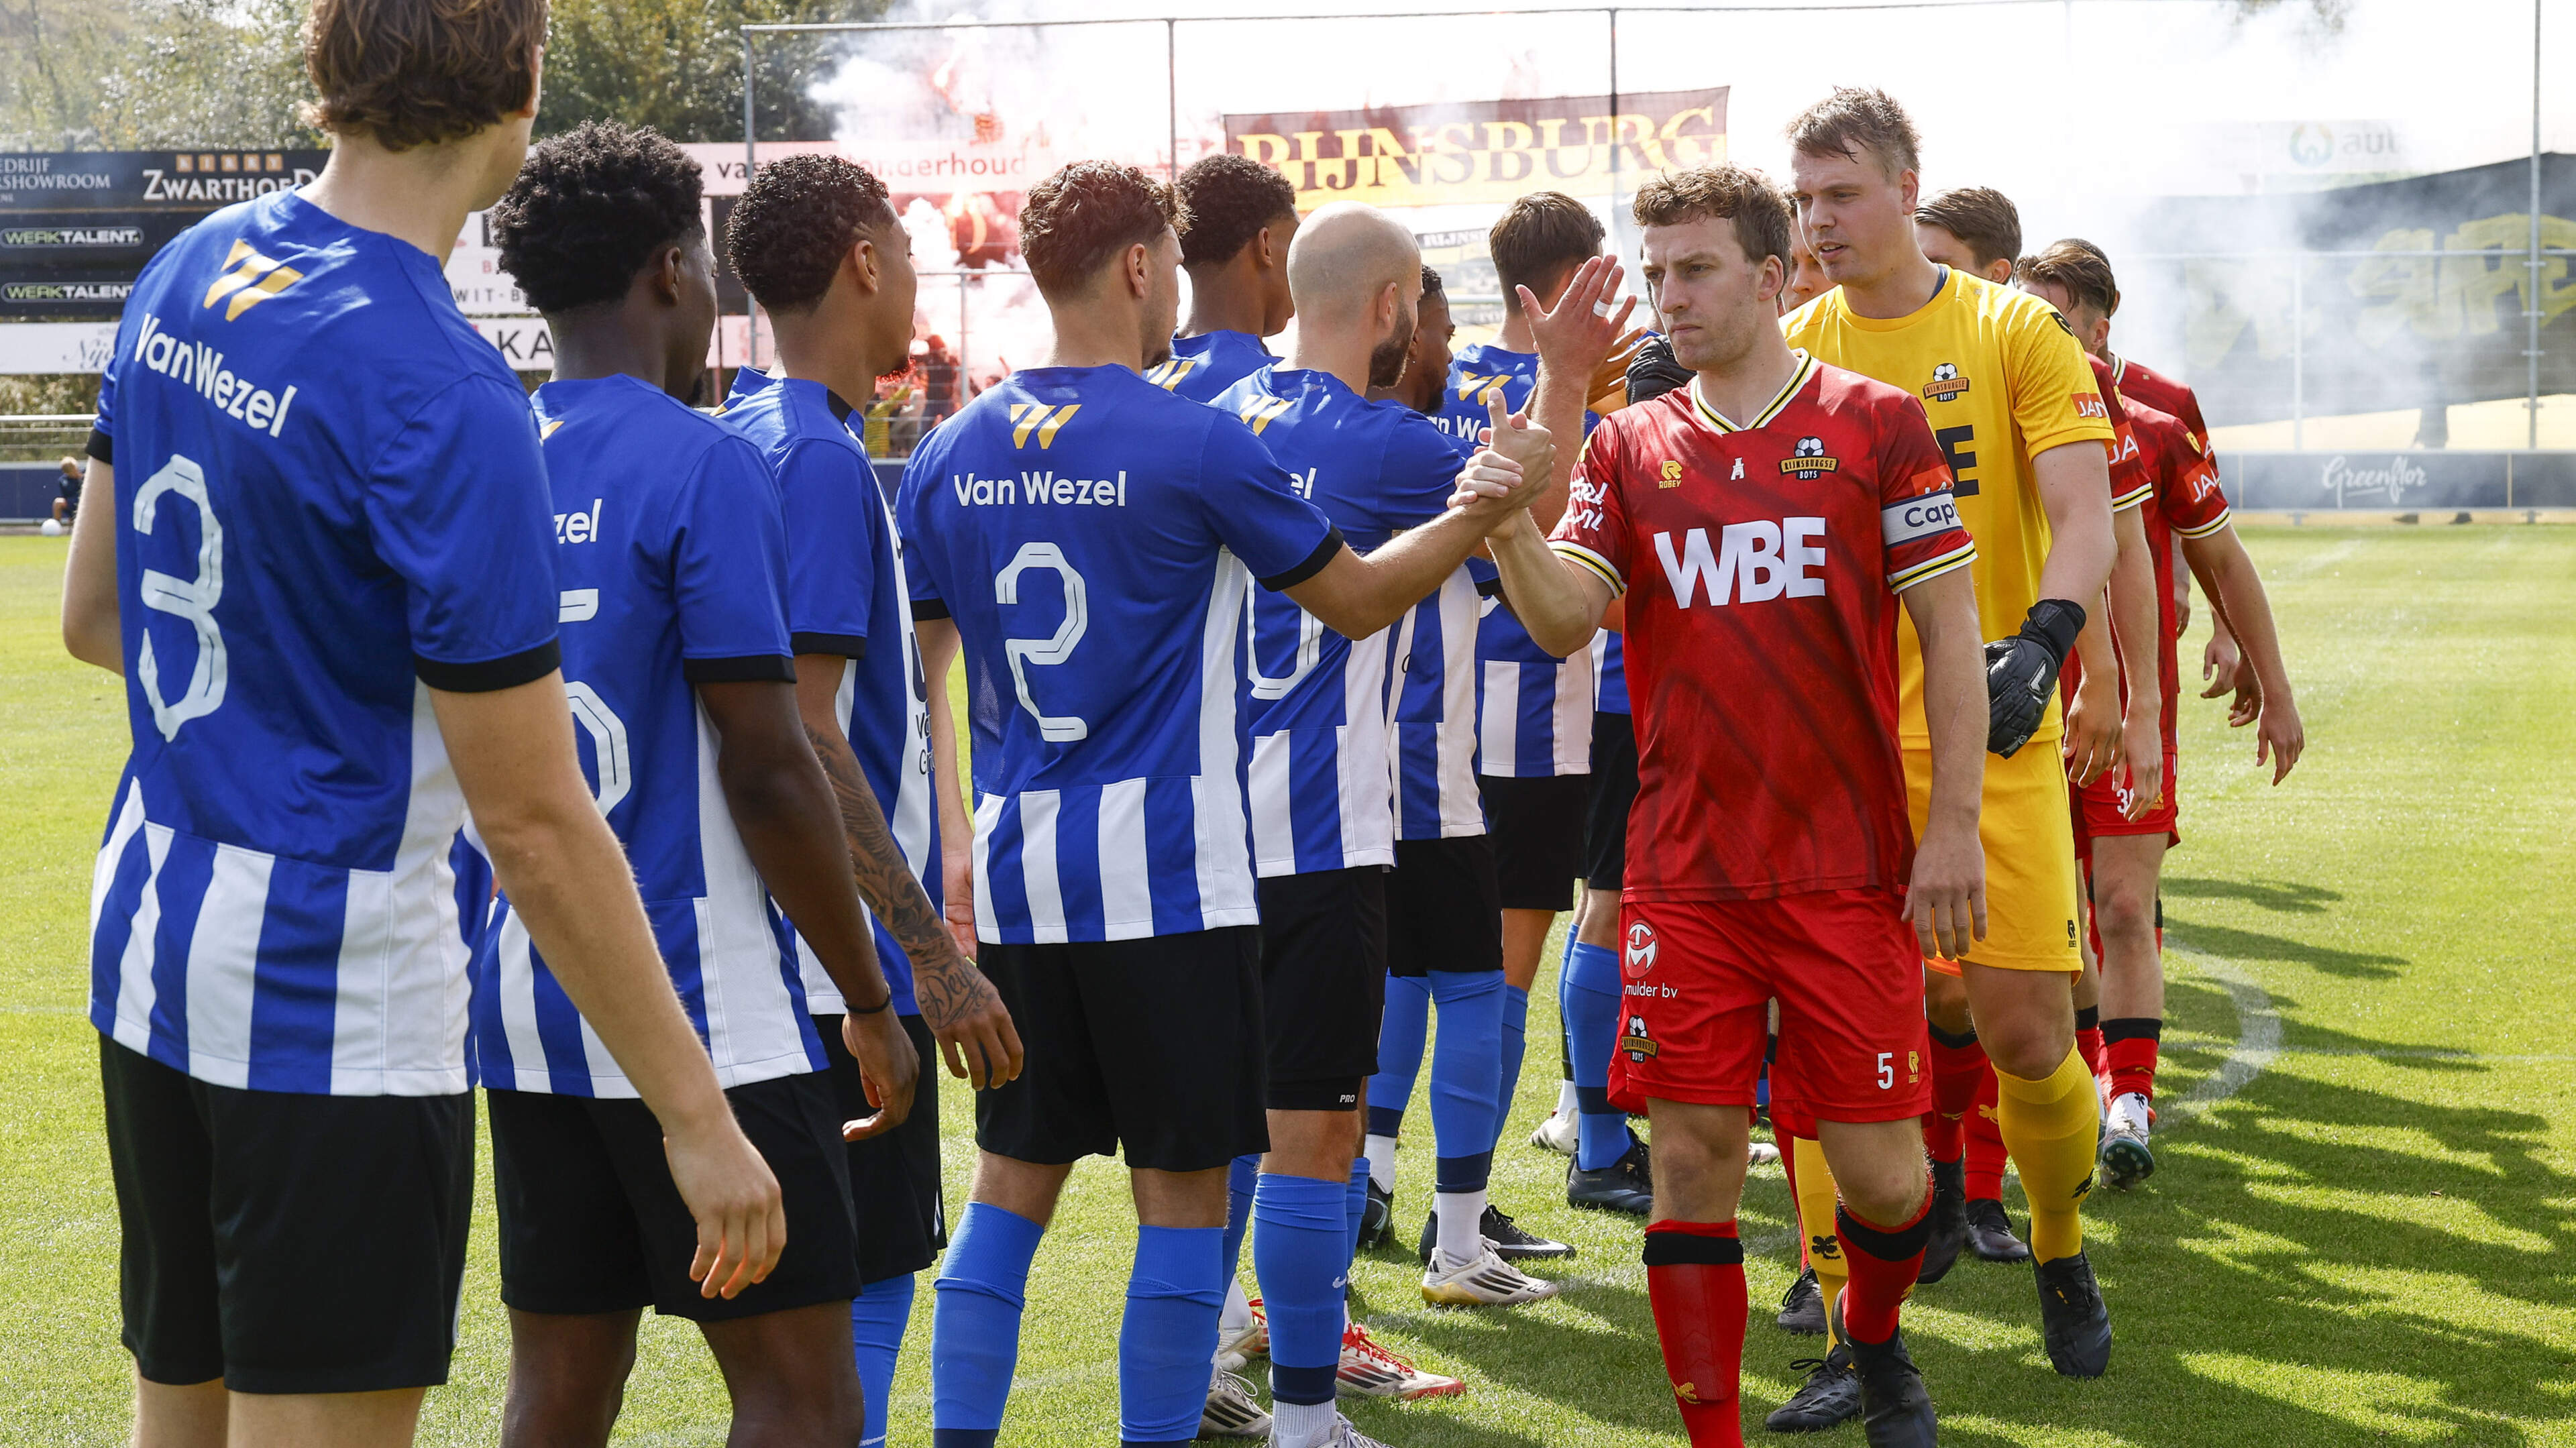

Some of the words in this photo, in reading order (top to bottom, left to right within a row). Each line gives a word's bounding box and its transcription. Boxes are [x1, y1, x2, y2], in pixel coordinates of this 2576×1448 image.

[1236, 105, 1715, 192] RIJNSBURG
[0, 158, 51, 174] DRIJF
[0, 174, 111, 190] SHOWROOM
[1939, 392, 1955, 401] BOYS
[1784, 459, 1833, 470] RIJNSBURGSE
[1799, 470, 1818, 480] BOYS
[953, 472, 1016, 507] Van
[1020, 470, 1127, 507] Wezel
[1653, 516, 1826, 610] WBE
[133, 453, 228, 743] 3
[996, 541, 1089, 742] 2
[1624, 981, 1658, 997] mulder
[1662, 983, 1678, 999] bv
[1877, 1052, 1894, 1090] 5
[1339, 1094, 1356, 1103] PRO
